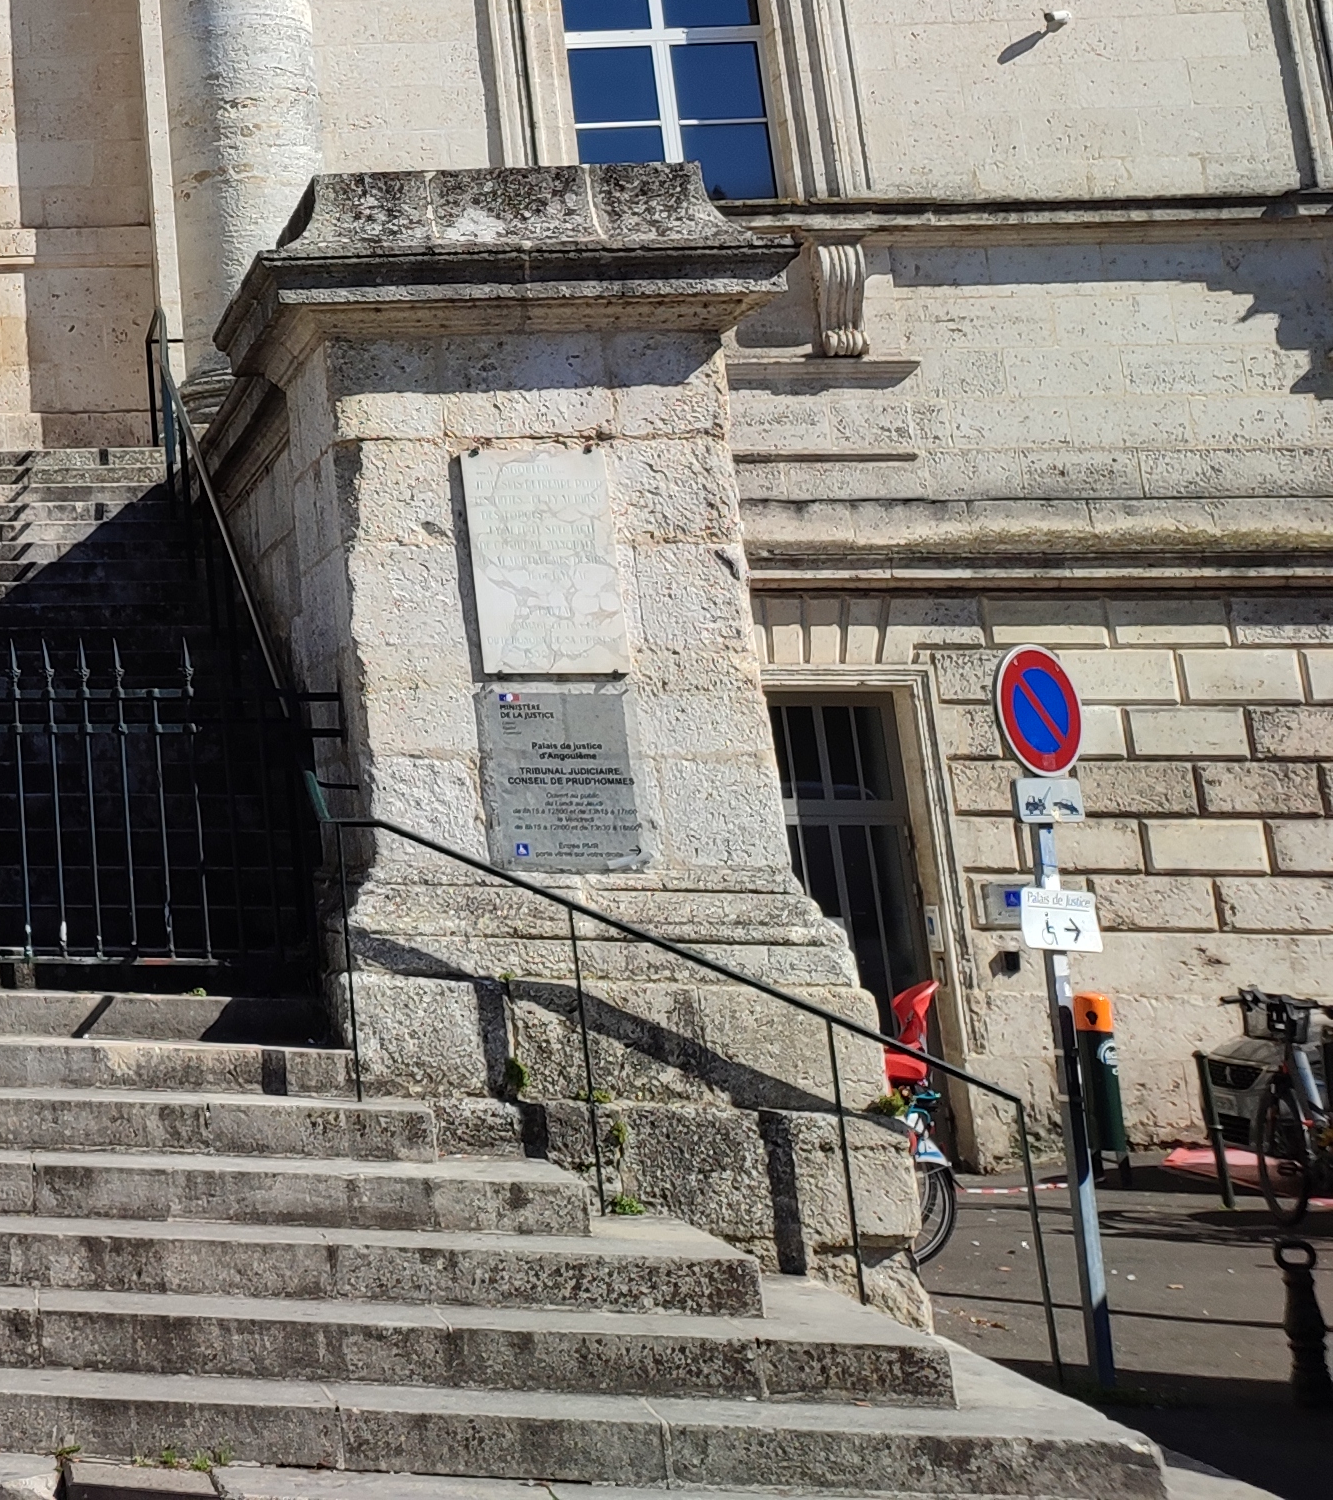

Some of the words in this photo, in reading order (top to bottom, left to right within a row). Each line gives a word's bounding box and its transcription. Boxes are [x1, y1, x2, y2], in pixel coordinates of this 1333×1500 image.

[524, 712, 554, 720] JUSTICE
[532, 742, 558, 750] Palais
[560, 742, 571, 750] de
[573, 742, 603, 751] justice
[539, 752, 597, 761] d'Angoulême
[519, 767, 567, 775] TRIBUNAL
[568, 767, 620, 775] JUDICIAIRE
[507, 777, 548, 785] CONSEIL
[550, 777, 564, 785] DE
[565, 777, 635, 786] PRUD'HOMMES
[1027, 891, 1050, 905] Palais
[1053, 892, 1064, 906] de
[1066, 894, 1091, 908] Justice
